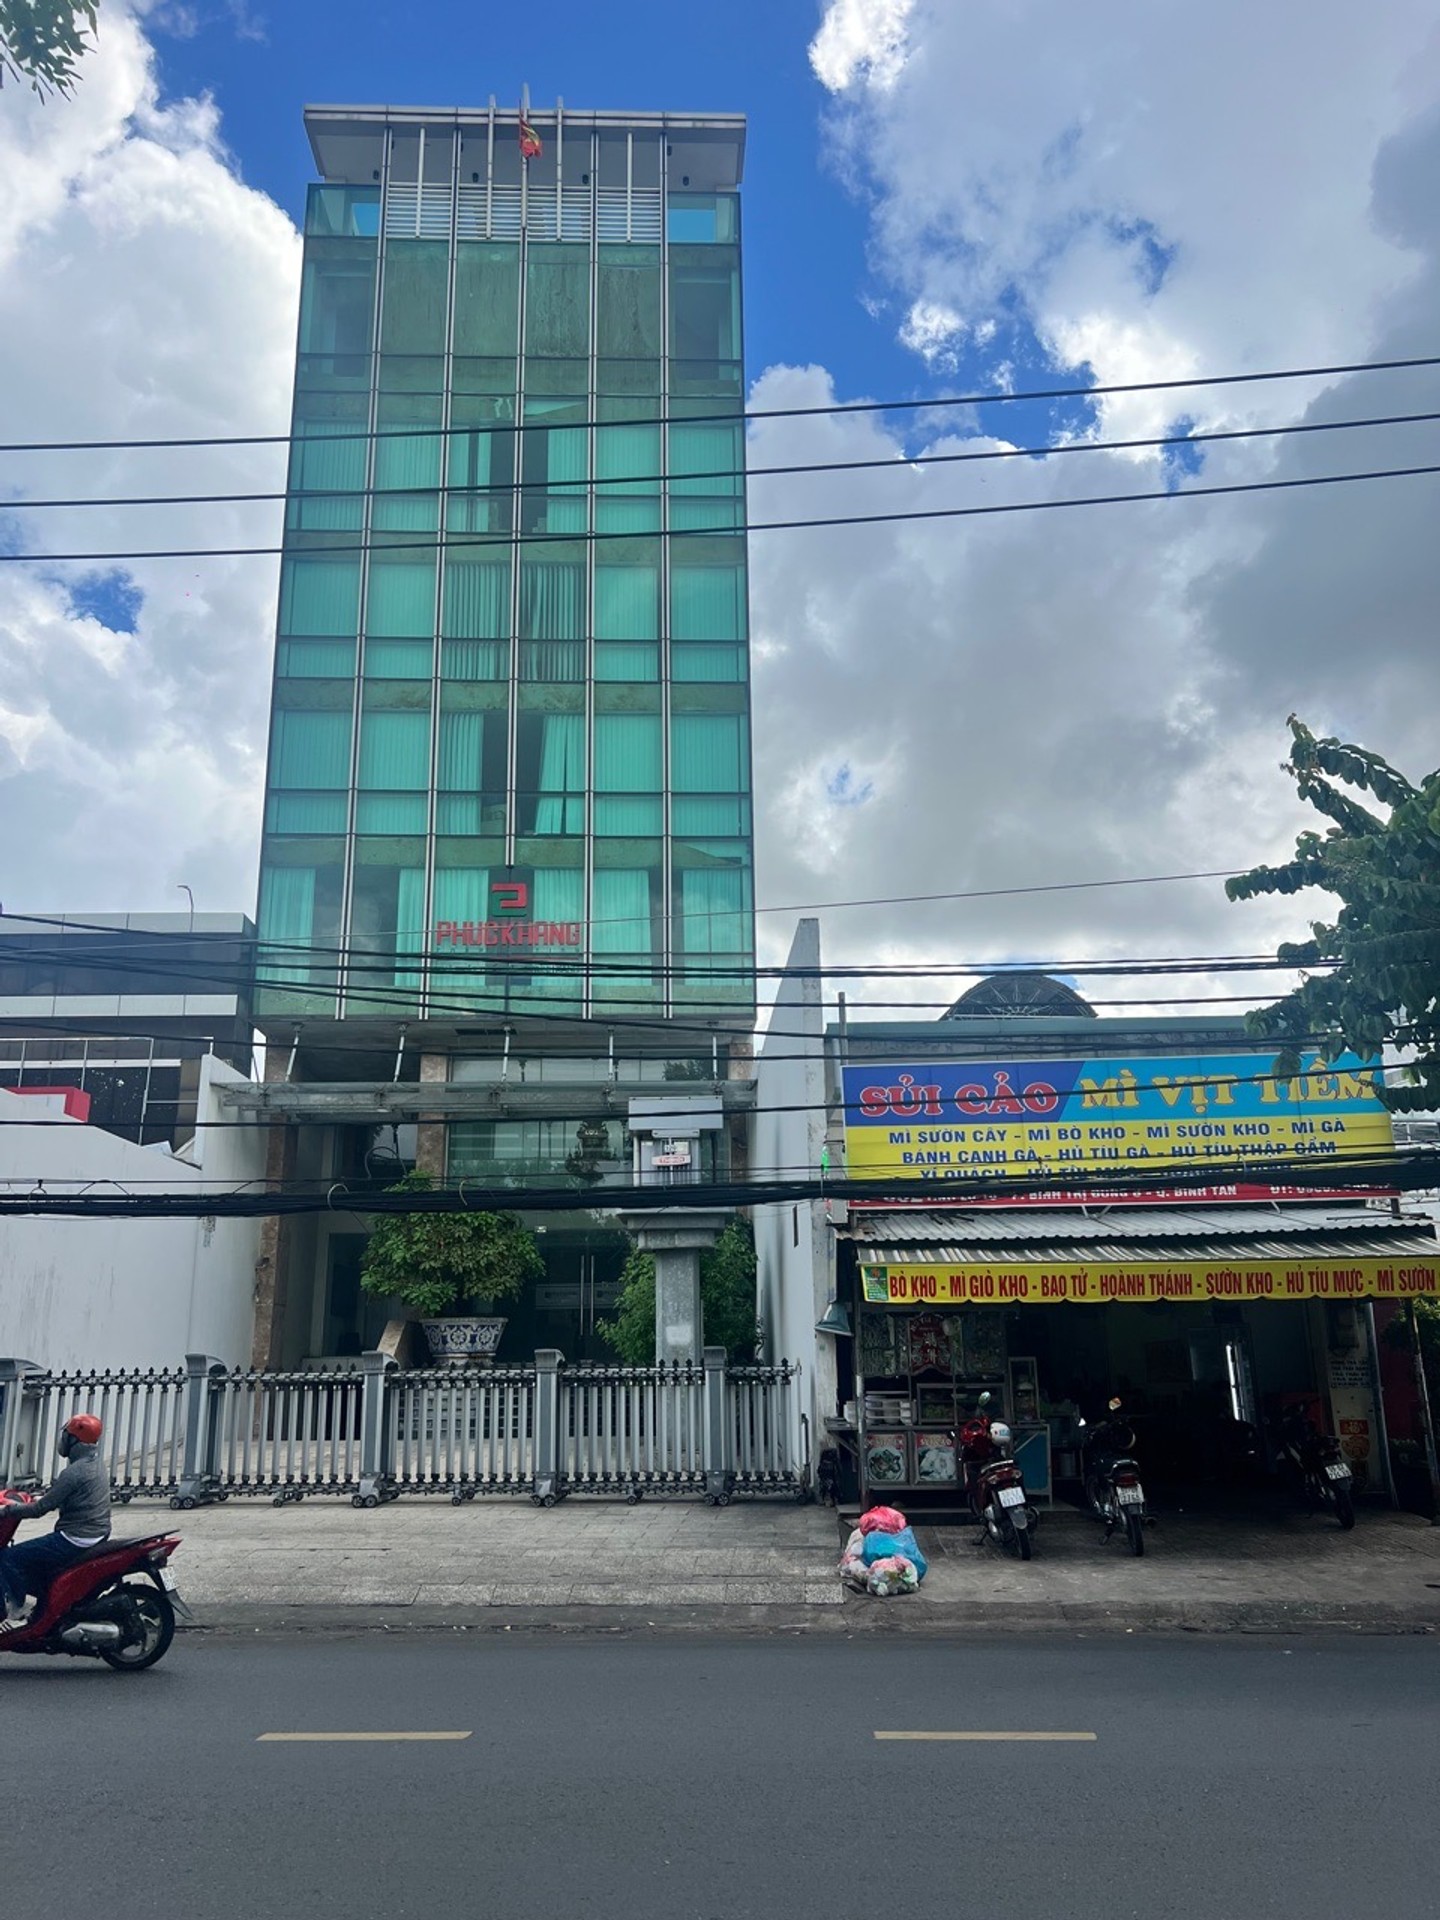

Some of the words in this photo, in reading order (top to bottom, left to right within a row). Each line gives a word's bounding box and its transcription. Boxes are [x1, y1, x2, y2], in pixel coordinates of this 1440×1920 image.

[860, 1074, 943, 1117] SỦI
[954, 1071, 1059, 1114] CẢO
[1080, 1068, 1140, 1109] MÌ
[1152, 1074, 1239, 1114] VỊT
[889, 1129, 911, 1144] MÌ
[918, 1127, 966, 1143] SƯỜN
[973, 1126, 1008, 1142] CÂY
[1029, 1126, 1051, 1141] MÌ
[1058, 1124, 1083, 1140] BÒ
[1089, 1125, 1126, 1140] KHO
[1147, 1124, 1170, 1138] MÌ
[1177, 1121, 1227, 1137] SƯỜN
[1233, 1122, 1271, 1136] KHO
[1291, 1119, 1314, 1134] MÌ
[1321, 1118, 1346, 1134] GÀ
[902, 1149, 950, 1164] BÁNH
[957, 1149, 1007, 1164] CANH
[1014, 1147, 1037, 1162] GÀ
[1059, 1146, 1083, 1161] HỦ
[1090, 1145, 1119, 1159] TÍU
[1127, 1143, 1150, 1159] GÀ
[1171, 1142, 1196, 1157] HỦ
[1203, 1140, 1233, 1156] TÍU
[1238, 1140, 1287, 1158] THẬP
[1294, 1136, 1337, 1155] CẨM
[890, 1270, 907, 1297] BÒ
[911, 1274, 937, 1297] KHO
[950, 1270, 966, 1297] MÌ
[970, 1269, 994, 1297] GIÒ
[999, 1273, 1029, 1297] KHO
[1041, 1273, 1066, 1296] BAO
[1071, 1267, 1089, 1296] TỬ
[1100, 1270, 1145, 1296] HOÀNH
[1149, 1269, 1192, 1296] THÁNH
[1206, 1267, 1242, 1295] SƯỜN
[1247, 1271, 1273, 1294] KHO
[1286, 1264, 1304, 1294] HỦ
[1308, 1266, 1329, 1294] TÍU
[1333, 1269, 1363, 1298] MỰC
[1377, 1265, 1395, 1291] MÌ
[1399, 1263, 1436, 1292] SƯỜN
